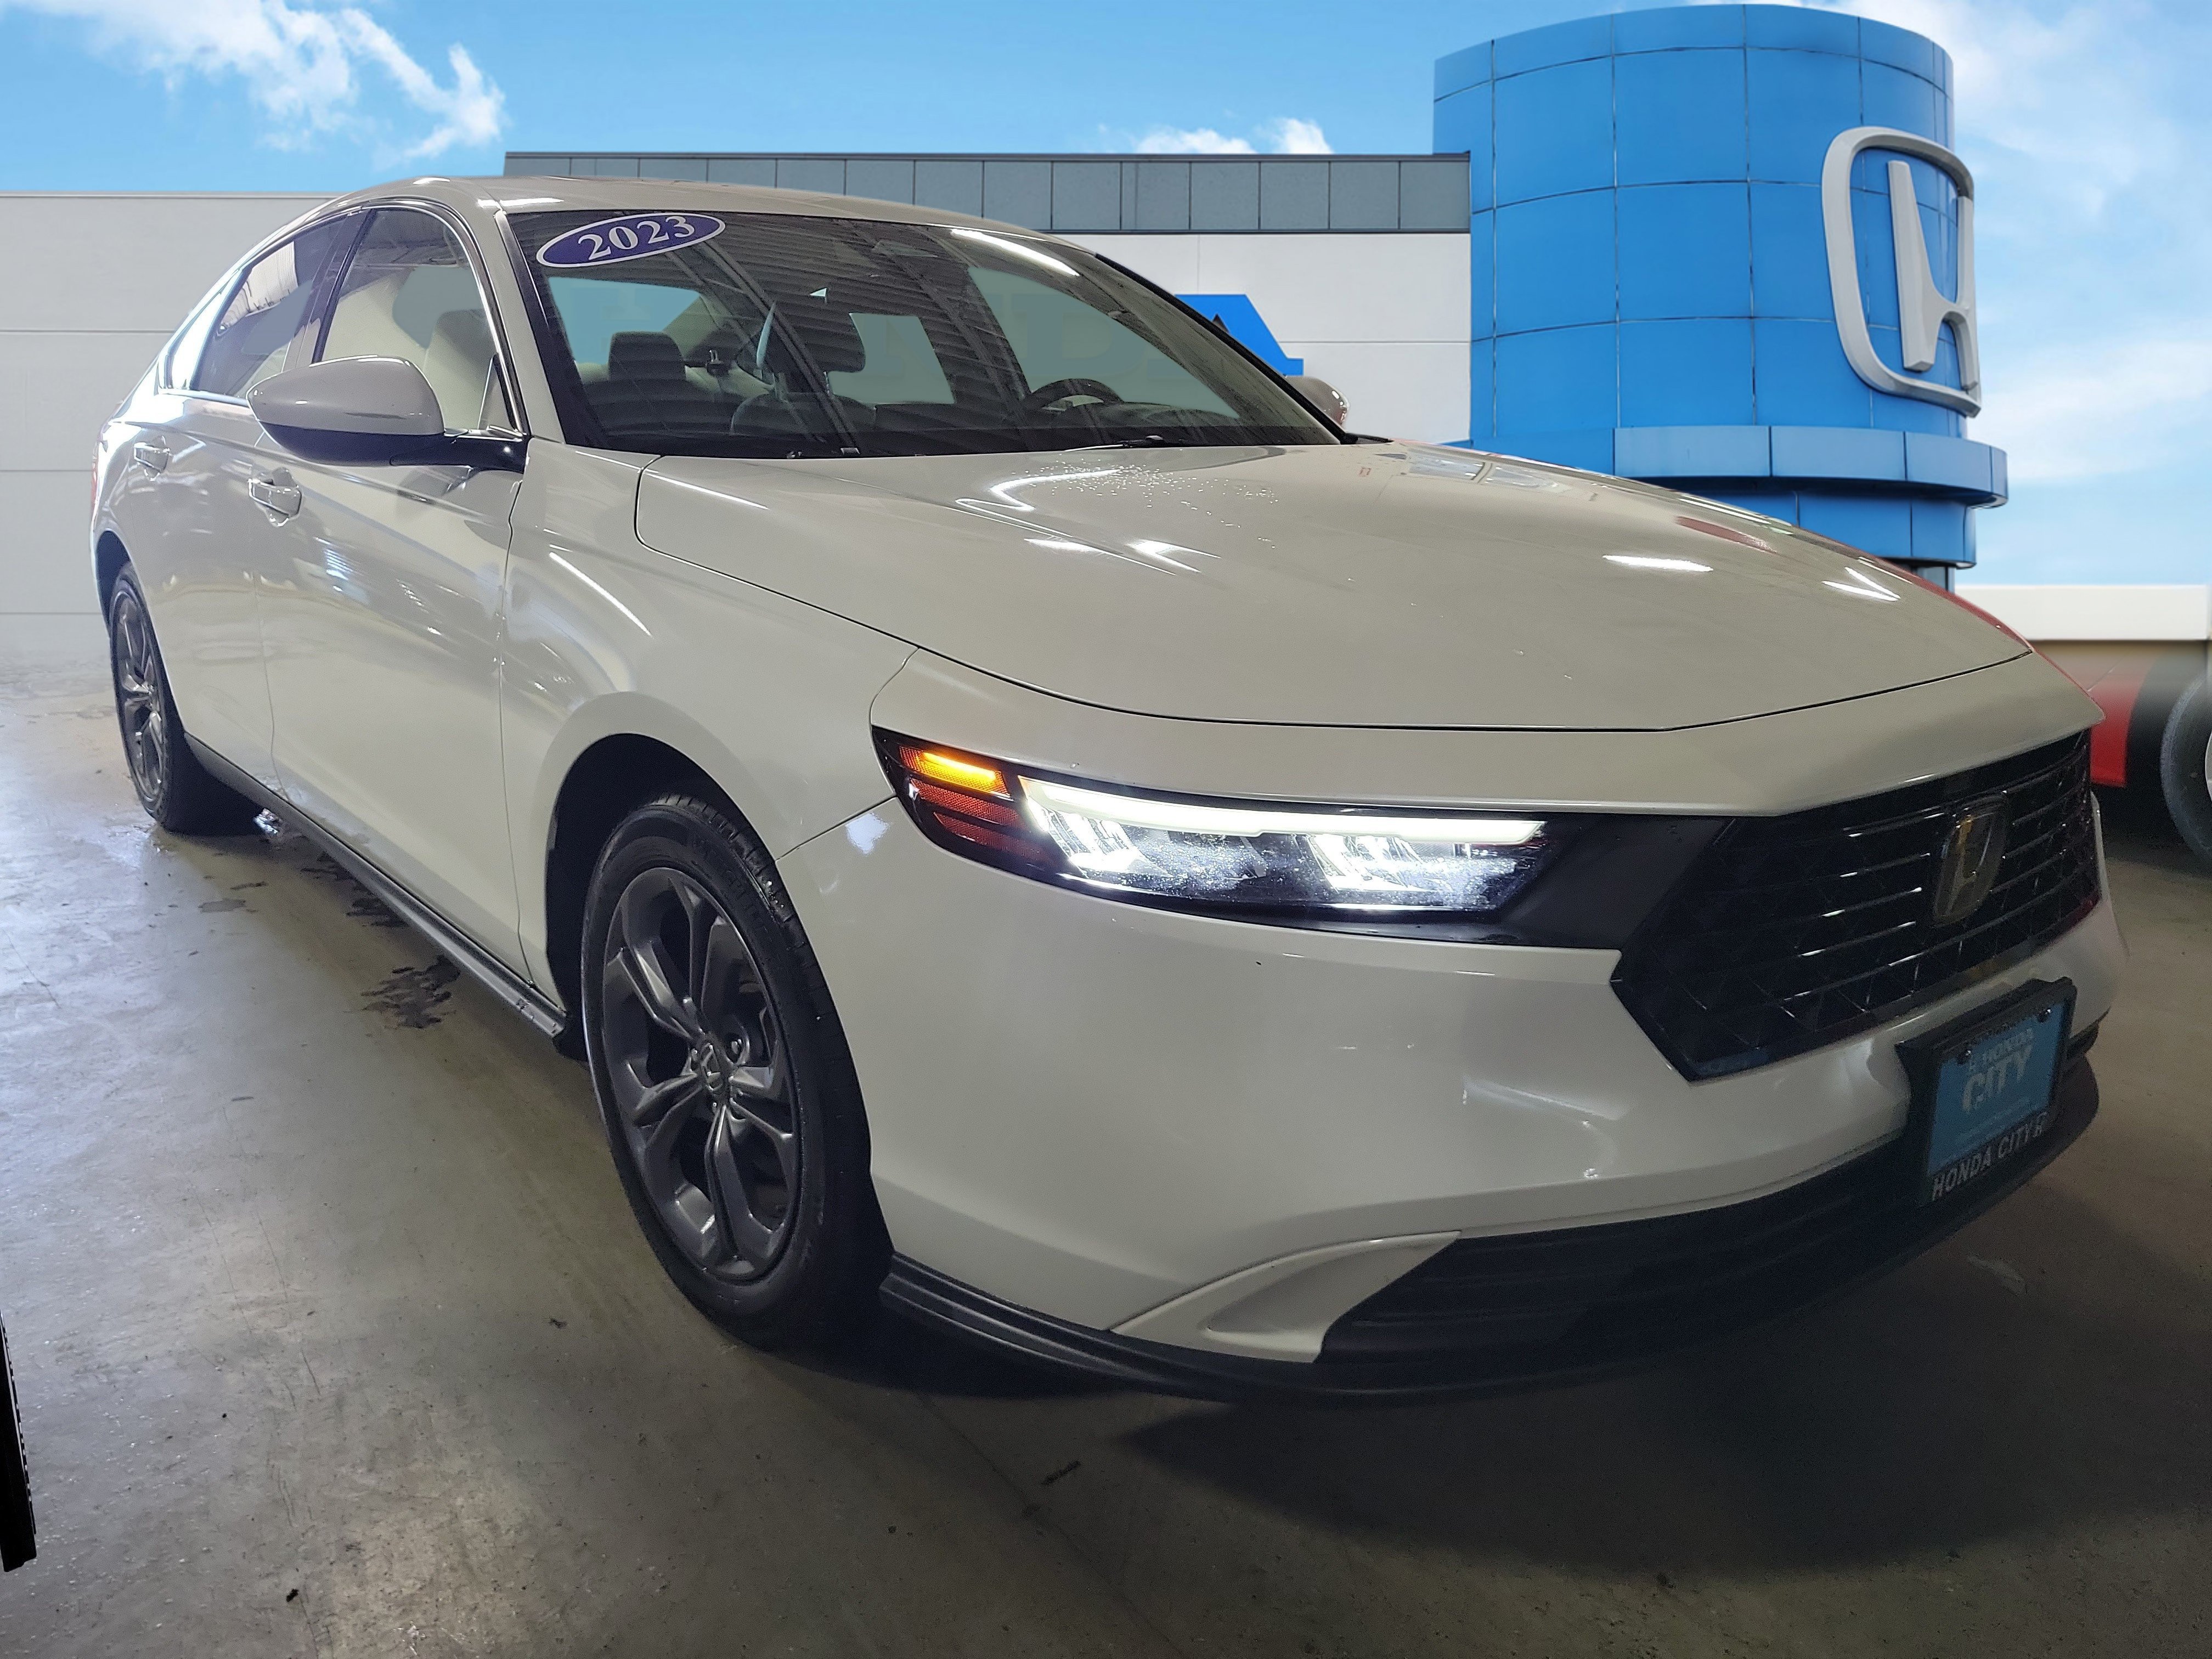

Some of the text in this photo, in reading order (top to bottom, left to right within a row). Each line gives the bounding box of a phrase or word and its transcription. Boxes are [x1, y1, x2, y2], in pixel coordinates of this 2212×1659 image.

[578, 215, 695, 261] 2023
[1962, 1044, 2034, 1114] CITY
[1931, 1146, 1992, 1201] HONDA
[1997, 1121, 2034, 1159] CITY
